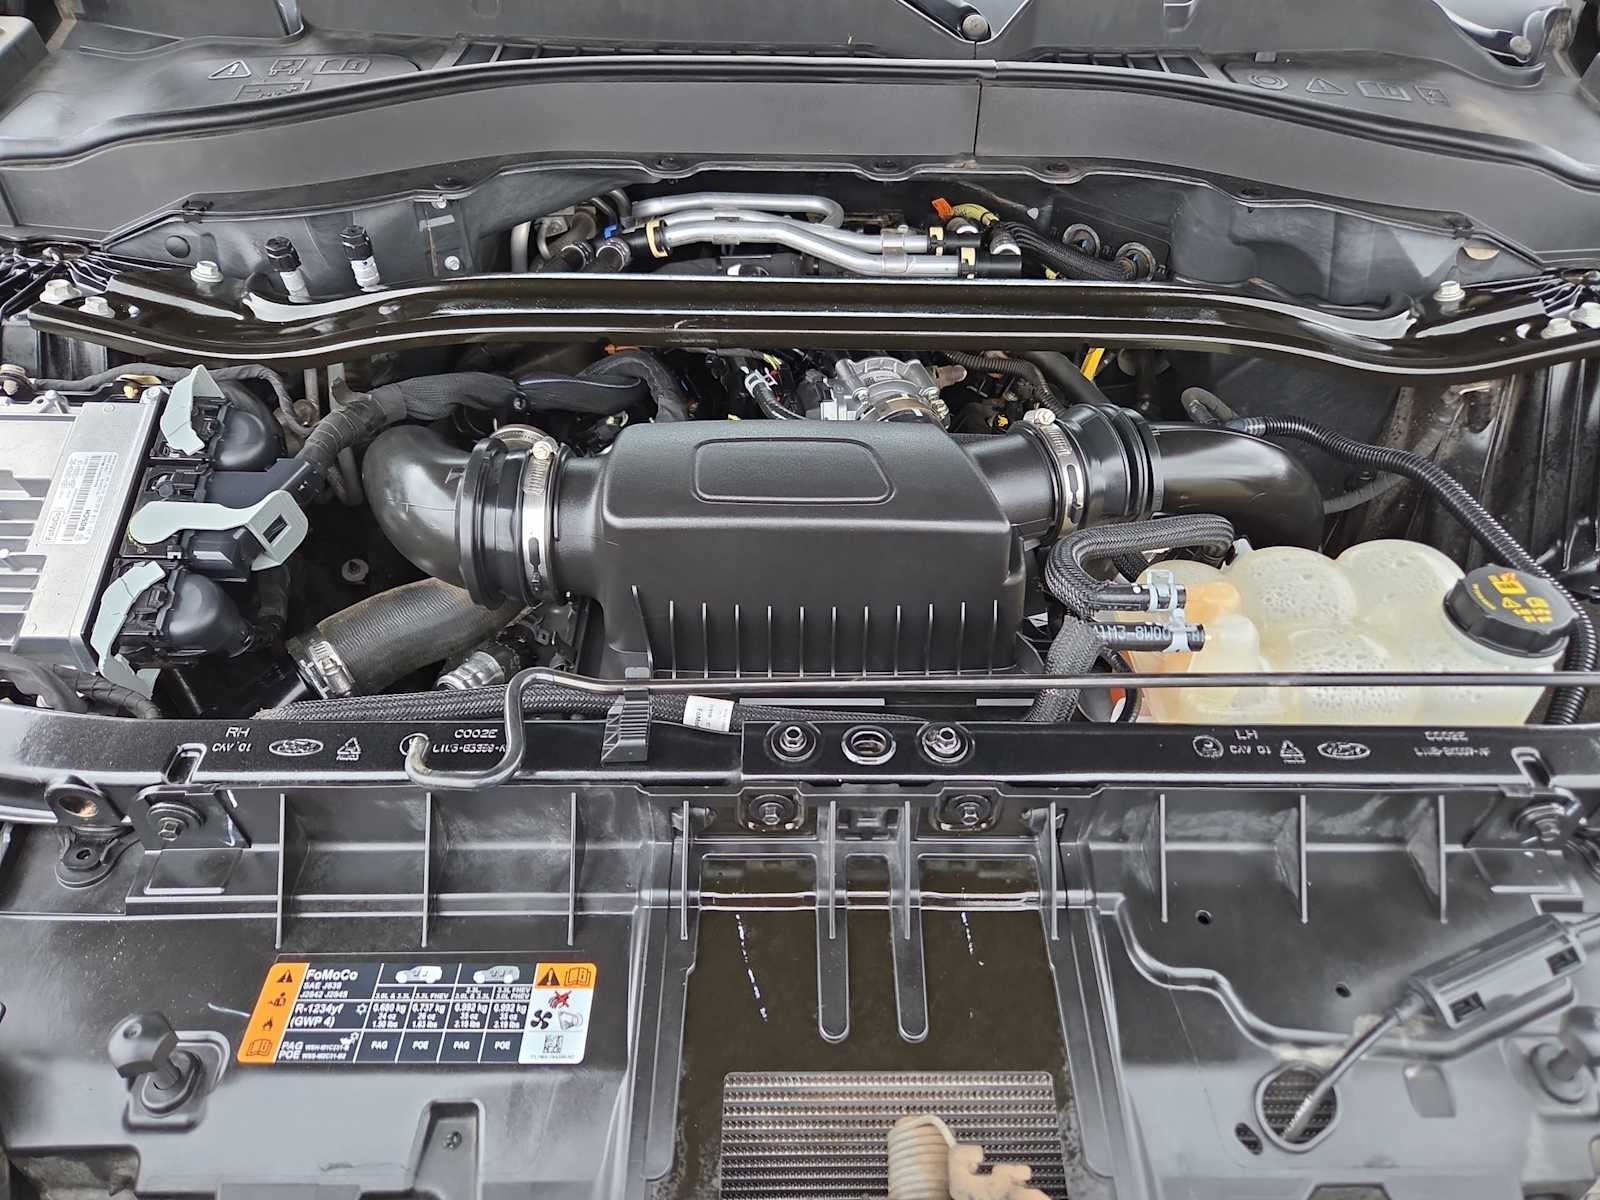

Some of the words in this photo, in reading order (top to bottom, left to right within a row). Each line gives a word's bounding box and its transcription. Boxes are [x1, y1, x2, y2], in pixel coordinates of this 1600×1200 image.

[225, 727, 250, 738] RH
[1235, 729, 1258, 740] LH
[306, 968, 358, 981] FoMoCo
[295, 1003, 343, 1015] R-1234yf
[395, 1003, 407, 1014] kg
[435, 1003, 446, 1014] kg
[477, 1003, 488, 1014] kg
[516, 1003, 527, 1014] kg
[290, 1016, 323, 1028] (GWP
[323, 1016, 336, 1028] 4)
[281, 1041, 303, 1051] PAG
[371, 1041, 387, 1050] PAG
[412, 1040, 429, 1050] POE
[453, 1040, 470, 1050] PAG
[495, 1040, 511, 1050] POE
[279, 1051, 300, 1060] POE
